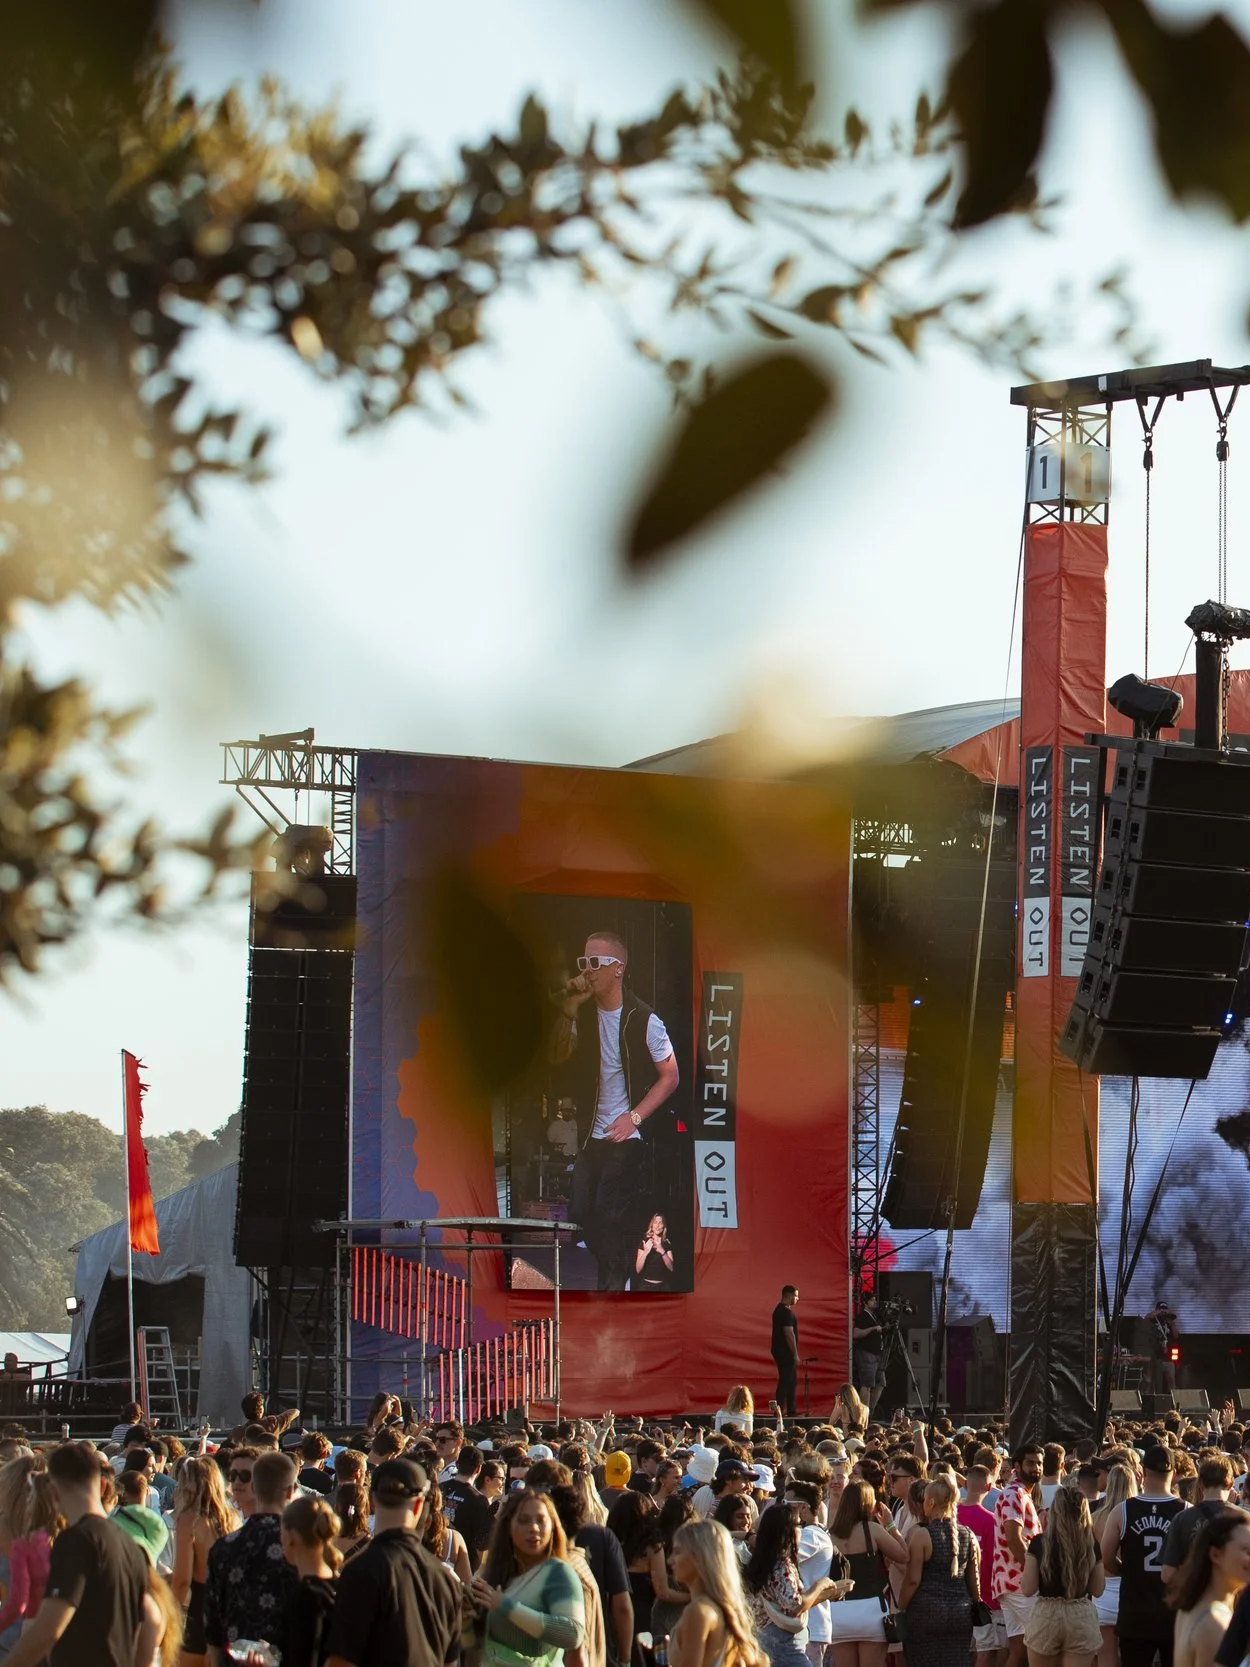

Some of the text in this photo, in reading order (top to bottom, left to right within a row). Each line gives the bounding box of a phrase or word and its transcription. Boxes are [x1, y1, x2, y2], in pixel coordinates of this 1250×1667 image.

[1040, 455, 1048, 489] 1
[1080, 452, 1093, 493] 1
[1069, 758, 1091, 885] LISTEN
[1028, 758, 1047, 967] LISTEN OUT
[703, 984, 734, 1218] LISTEN OUT
[1130, 1516, 1171, 1534] LEONAR
[1144, 1536, 1162, 1572] 2
